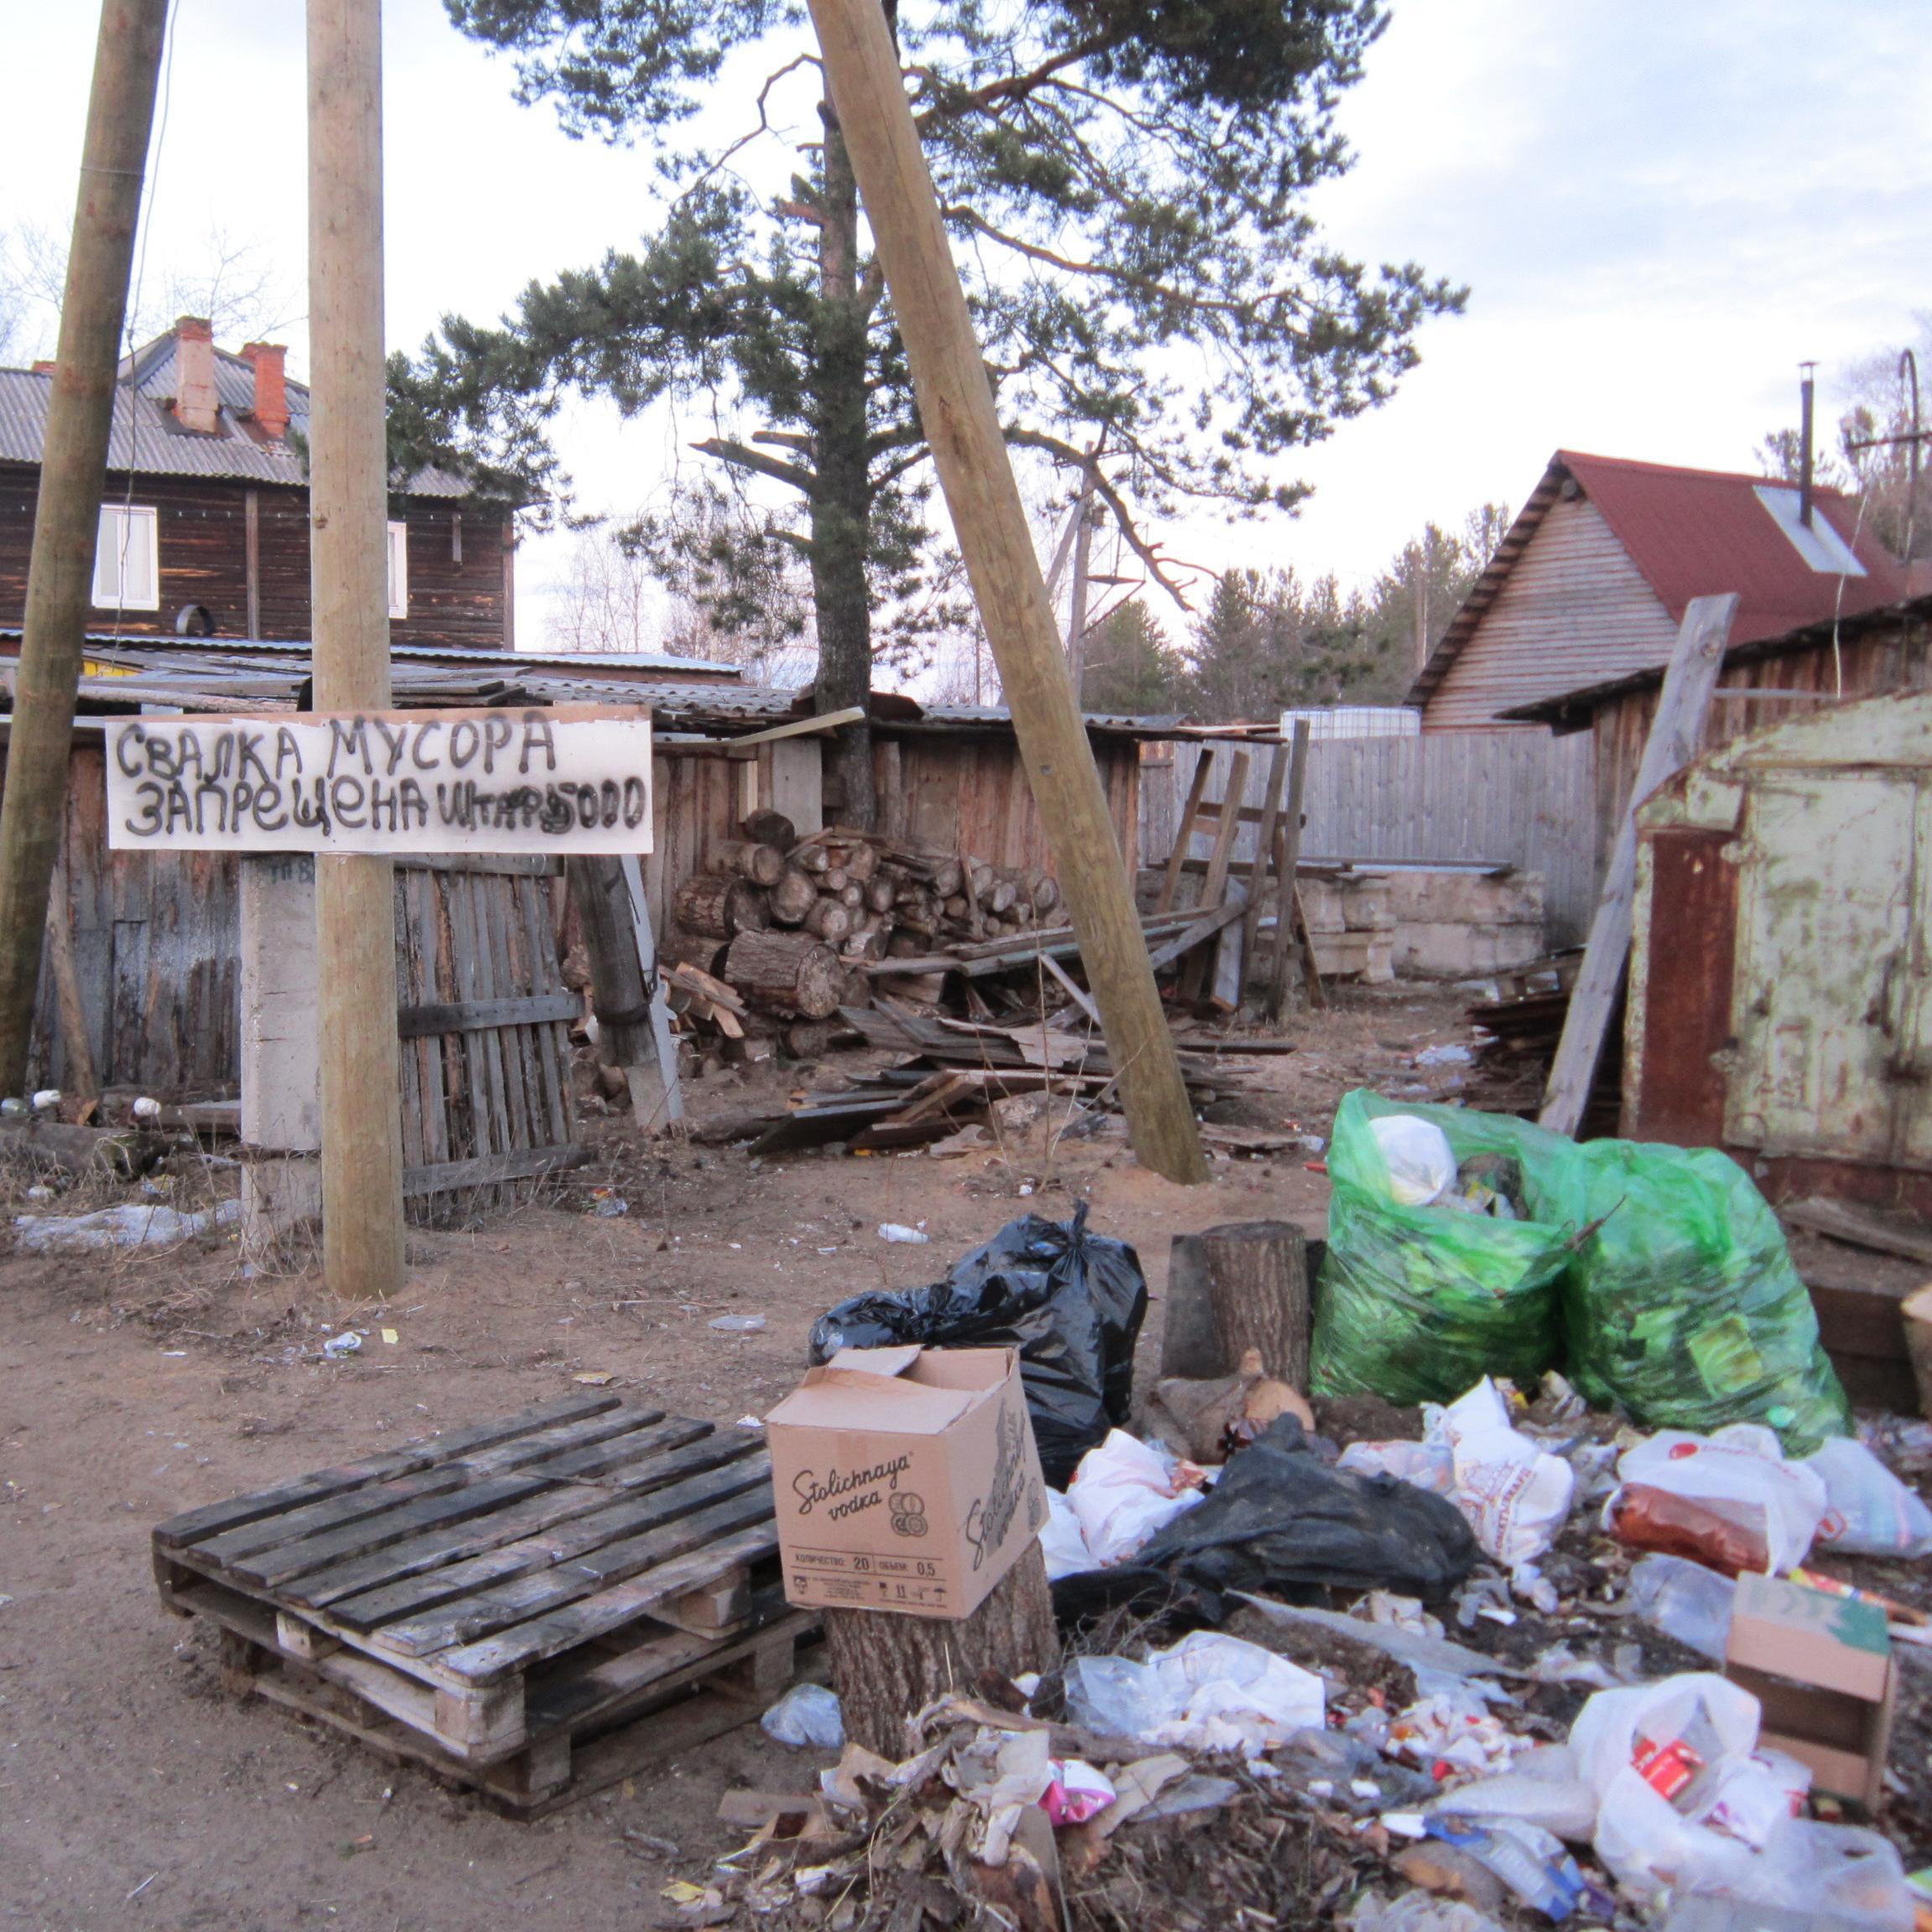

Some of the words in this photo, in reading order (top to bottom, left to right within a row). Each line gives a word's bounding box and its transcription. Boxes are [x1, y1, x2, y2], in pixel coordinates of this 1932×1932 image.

[117, 724, 303, 783] СВАЛКА
[326, 712, 556, 778] МУСОРА
[792, 1454, 911, 1516] Stolichnaya
[828, 1490, 883, 1521] vodka
[853, 1556, 870, 1571] 20
